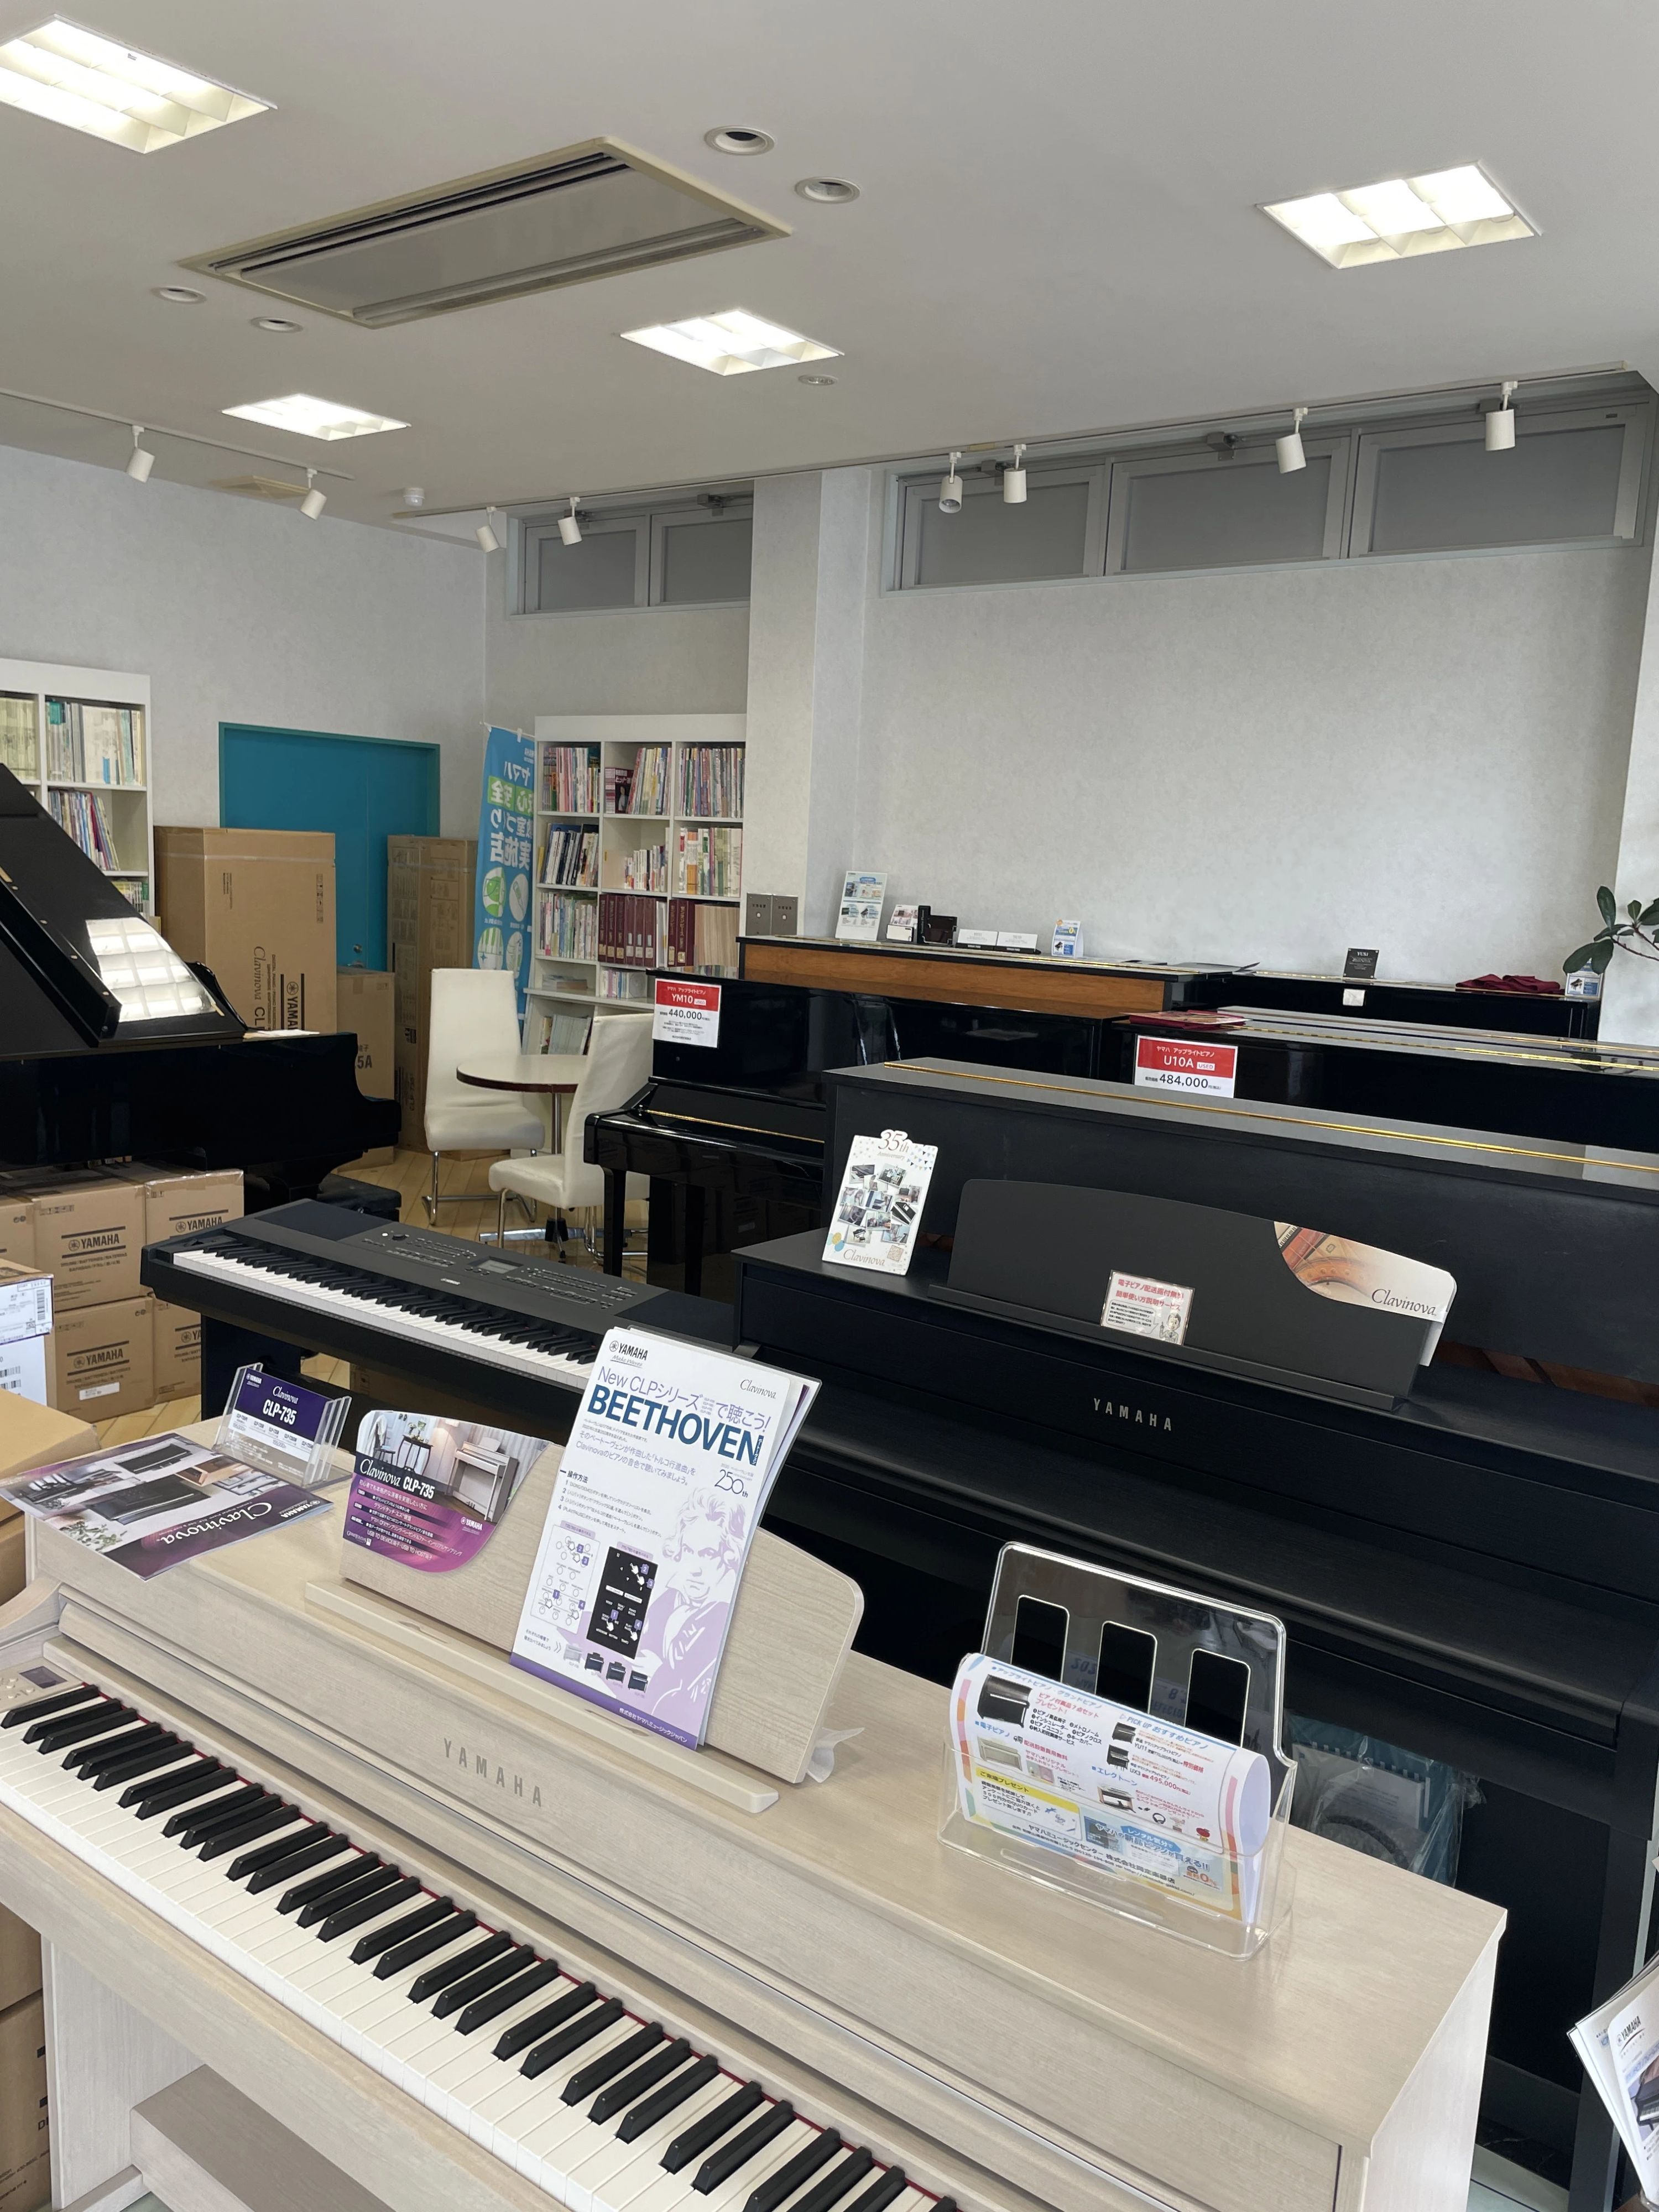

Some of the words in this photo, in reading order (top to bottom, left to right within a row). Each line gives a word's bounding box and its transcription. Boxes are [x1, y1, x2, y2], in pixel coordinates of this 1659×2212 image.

[253, 946, 266, 1000] Clavinova
[672, 994, 693, 1004] YM10
[287, 997, 299, 1030] YAMA
[1164, 1055, 1194, 1068] U10A
[1173, 1047, 1214, 1057] アップライトピアノ
[878, 1132, 910, 1152] 35th
[877, 1151, 905, 1161] Anniversary
[81, 1234, 119, 1249] YAMAHA
[843, 1249, 885, 1266] Clavinova
[1371, 1288, 1436, 1316] Clavinova
[86, 1348, 123, 1365] YAMAHA
[612, 1355, 627, 1364] Make
[619, 1343, 648, 1360] YAMAHA
[273, 1386, 299, 1404] Clavinova
[598, 1366, 628, 1387] New
[630, 1376, 703, 1410] CLPシリーズ
[740, 1379, 776, 1399] Clavinova
[263, 1399, 297, 1425] CLP-735
[1094, 1398, 1171, 1431] YAMAHA
[588, 1384, 764, 1467] BEETHOVEN
[360, 1459, 401, 1486] Clavinova
[403, 1476, 435, 1499] CLP-735
[567, 1470, 588, 1483] 操作方法
[280, 1502, 313, 1518] YAMAHA
[161, 1502, 272, 1545] Clavinova
[466, 1519, 483, 1531] YAMAHA
[619, 1708, 688, 1743] 株式会社ヤマハミュージックジャパン
[980, 1721, 1010, 1737] 電子ピアノ
[1127, 1716, 1141, 1725] PICK
[1152, 1726, 1208, 1749] おすすめピアノ
[1134, 1743, 1147, 1751] YU11
[1026, 1750, 1066, 1768] ヤマハオリジナル
[444, 1738, 541, 1807] YAMAHA
[980, 1771, 1029, 1793] ご来場プレゼント
[1097, 1767, 1137, 1786] エレクトーン
[1028, 1824, 1103, 1855] ヤマハミュージックセンター
[1621, 2016, 1641, 2040] YAMAHA
